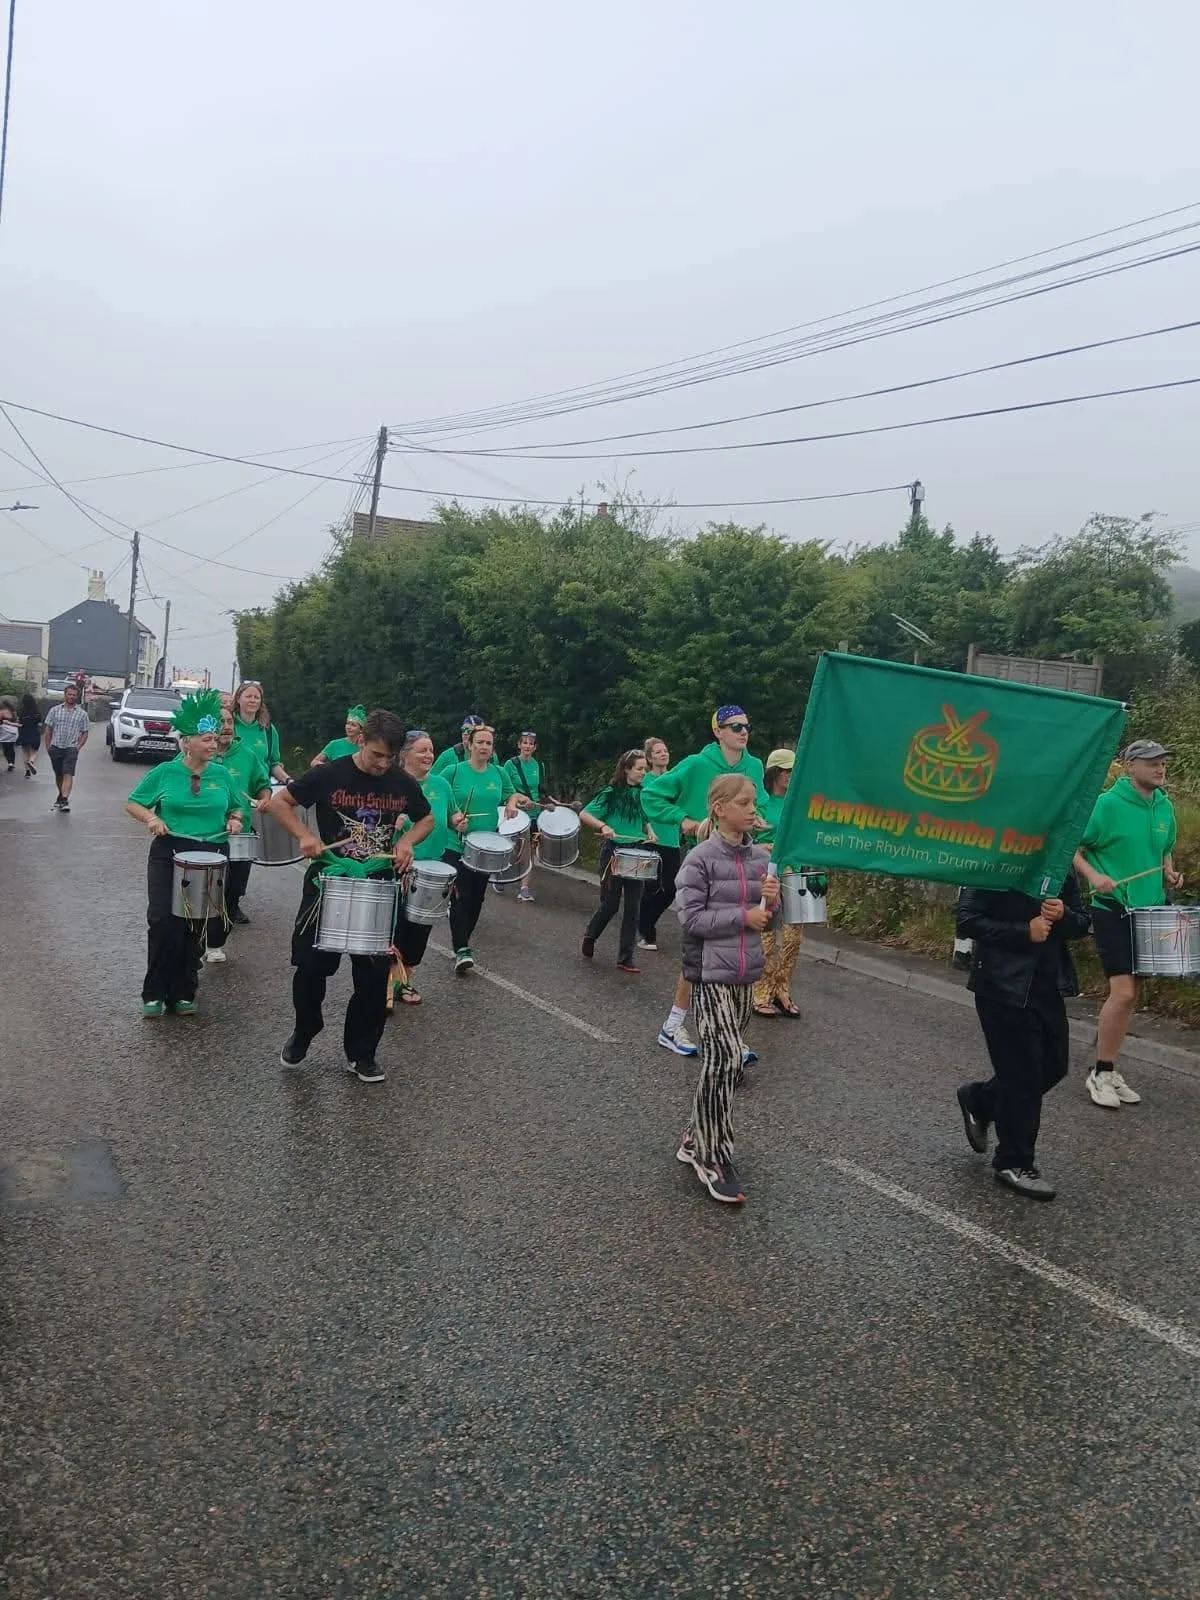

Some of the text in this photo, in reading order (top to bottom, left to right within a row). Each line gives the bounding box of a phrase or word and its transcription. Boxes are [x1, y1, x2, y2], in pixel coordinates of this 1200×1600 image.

[807, 794, 1044, 855] Newquay Samba Ban
[815, 831, 844, 847] Feel
[848, 835, 872, 850] The
[875, 840, 932, 865] Rhythm,
[937, 851, 978, 871] Drum
[982, 859, 995, 872] In
